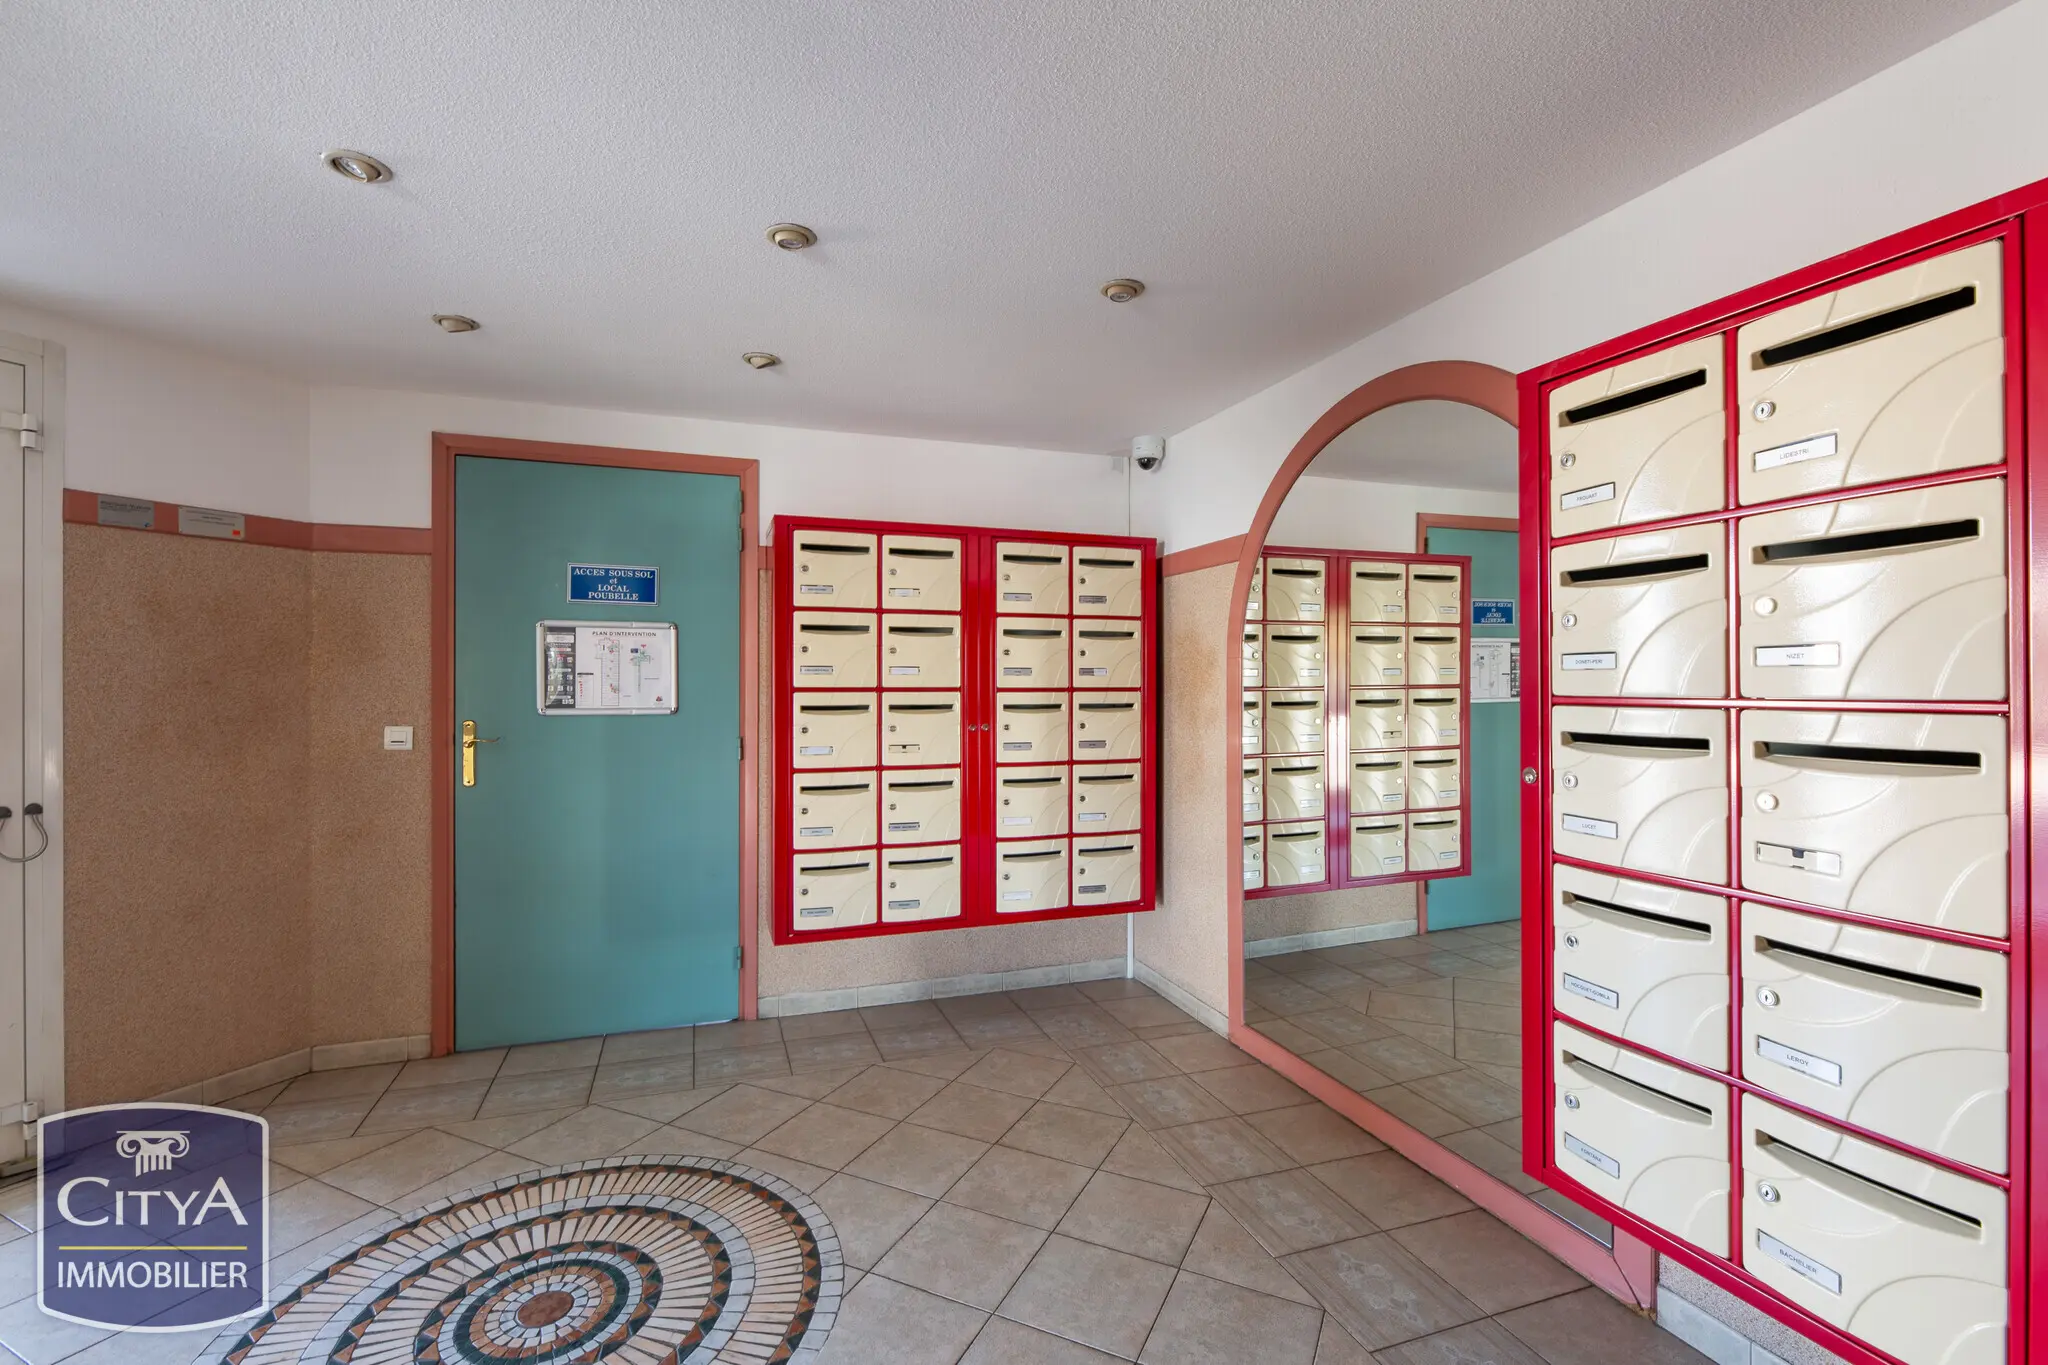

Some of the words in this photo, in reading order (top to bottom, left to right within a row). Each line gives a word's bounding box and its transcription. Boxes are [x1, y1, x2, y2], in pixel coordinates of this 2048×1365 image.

[574, 568, 605, 576] ACCES
[608, 569, 633, 577] SOUS
[634, 571, 653, 579] SOL
[597, 584, 630, 592] LOCAL
[588, 591, 639, 601] POUBELLE
[1786, 1054, 1809, 1067] LEROY
[1779, 1248, 1818, 1275] BACHELIER
